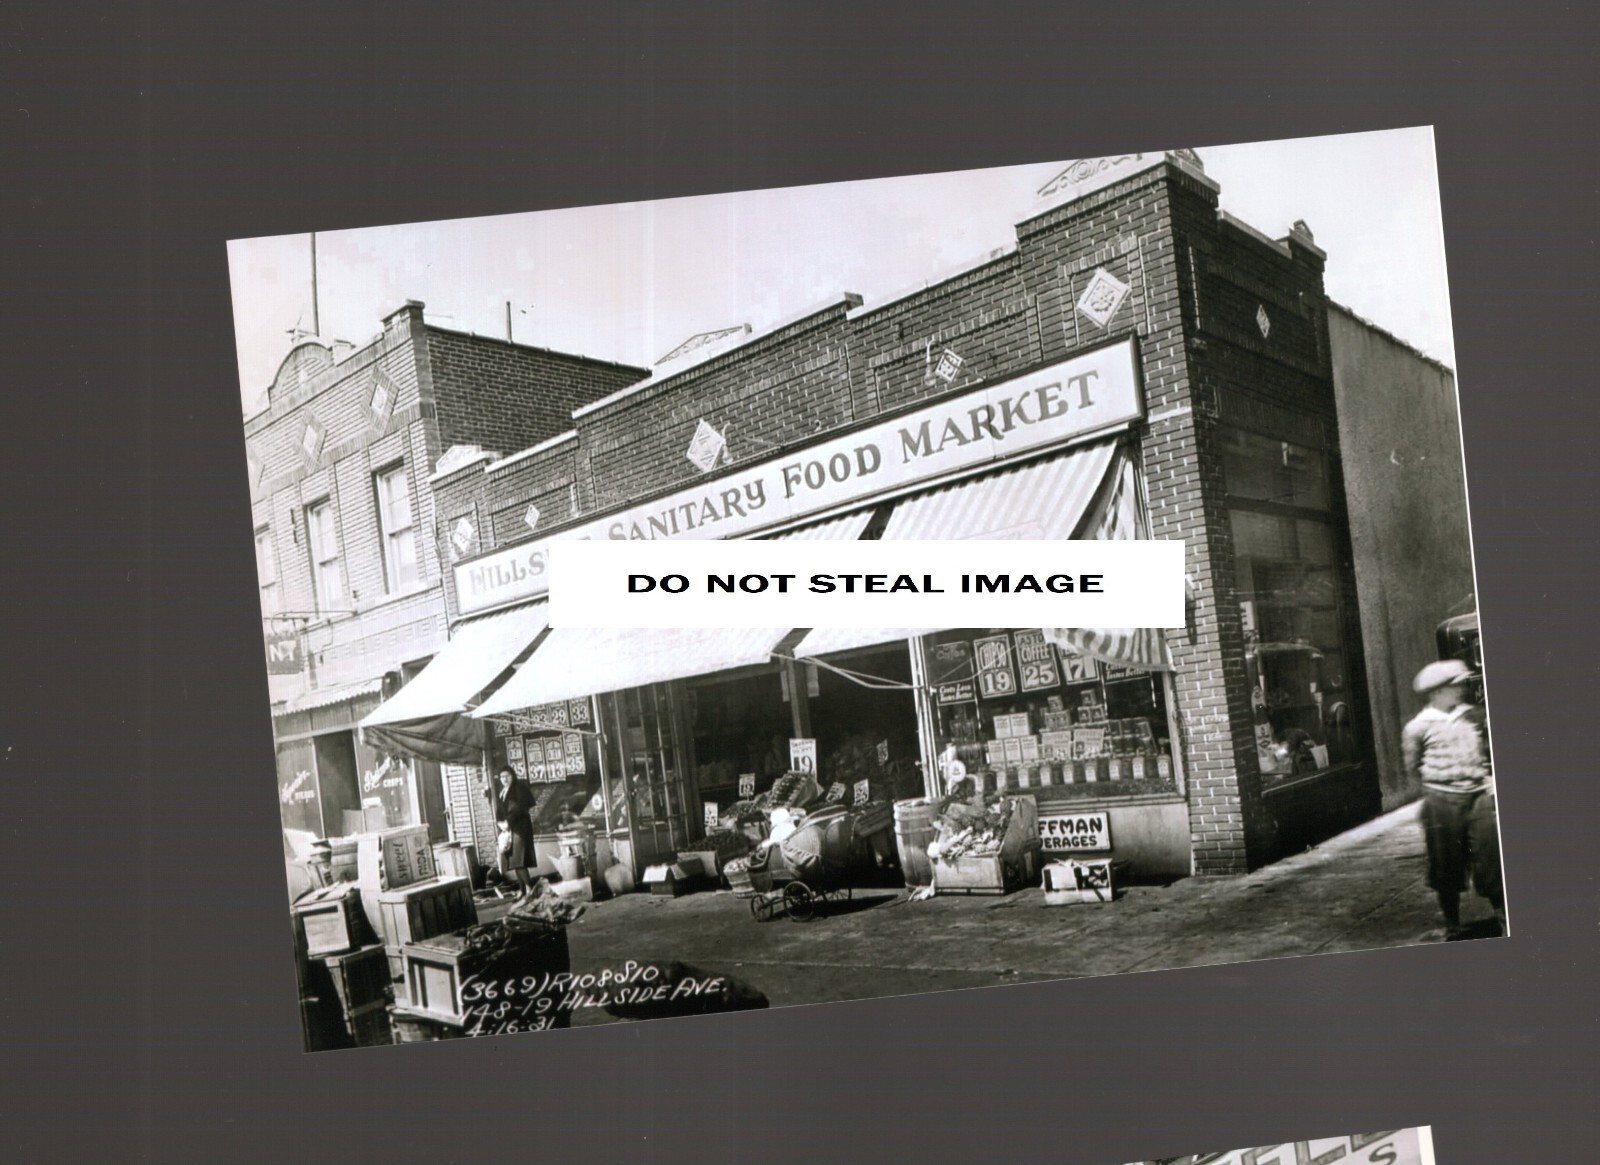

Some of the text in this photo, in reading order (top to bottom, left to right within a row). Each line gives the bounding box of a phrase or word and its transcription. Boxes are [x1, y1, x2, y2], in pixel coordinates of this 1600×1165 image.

[468, 370, 1099, 596] HILLS SANITARY FOOD MARKET
[1020, 633, 1045, 645] ASTO
[1022, 644, 1050, 662] COFFEE
[985, 671, 1010, 693] 19
[1025, 662, 1054, 687] 25
[1038, 817, 1103, 836] FFMAN
[1039, 835, 1098, 849] ERAGES
